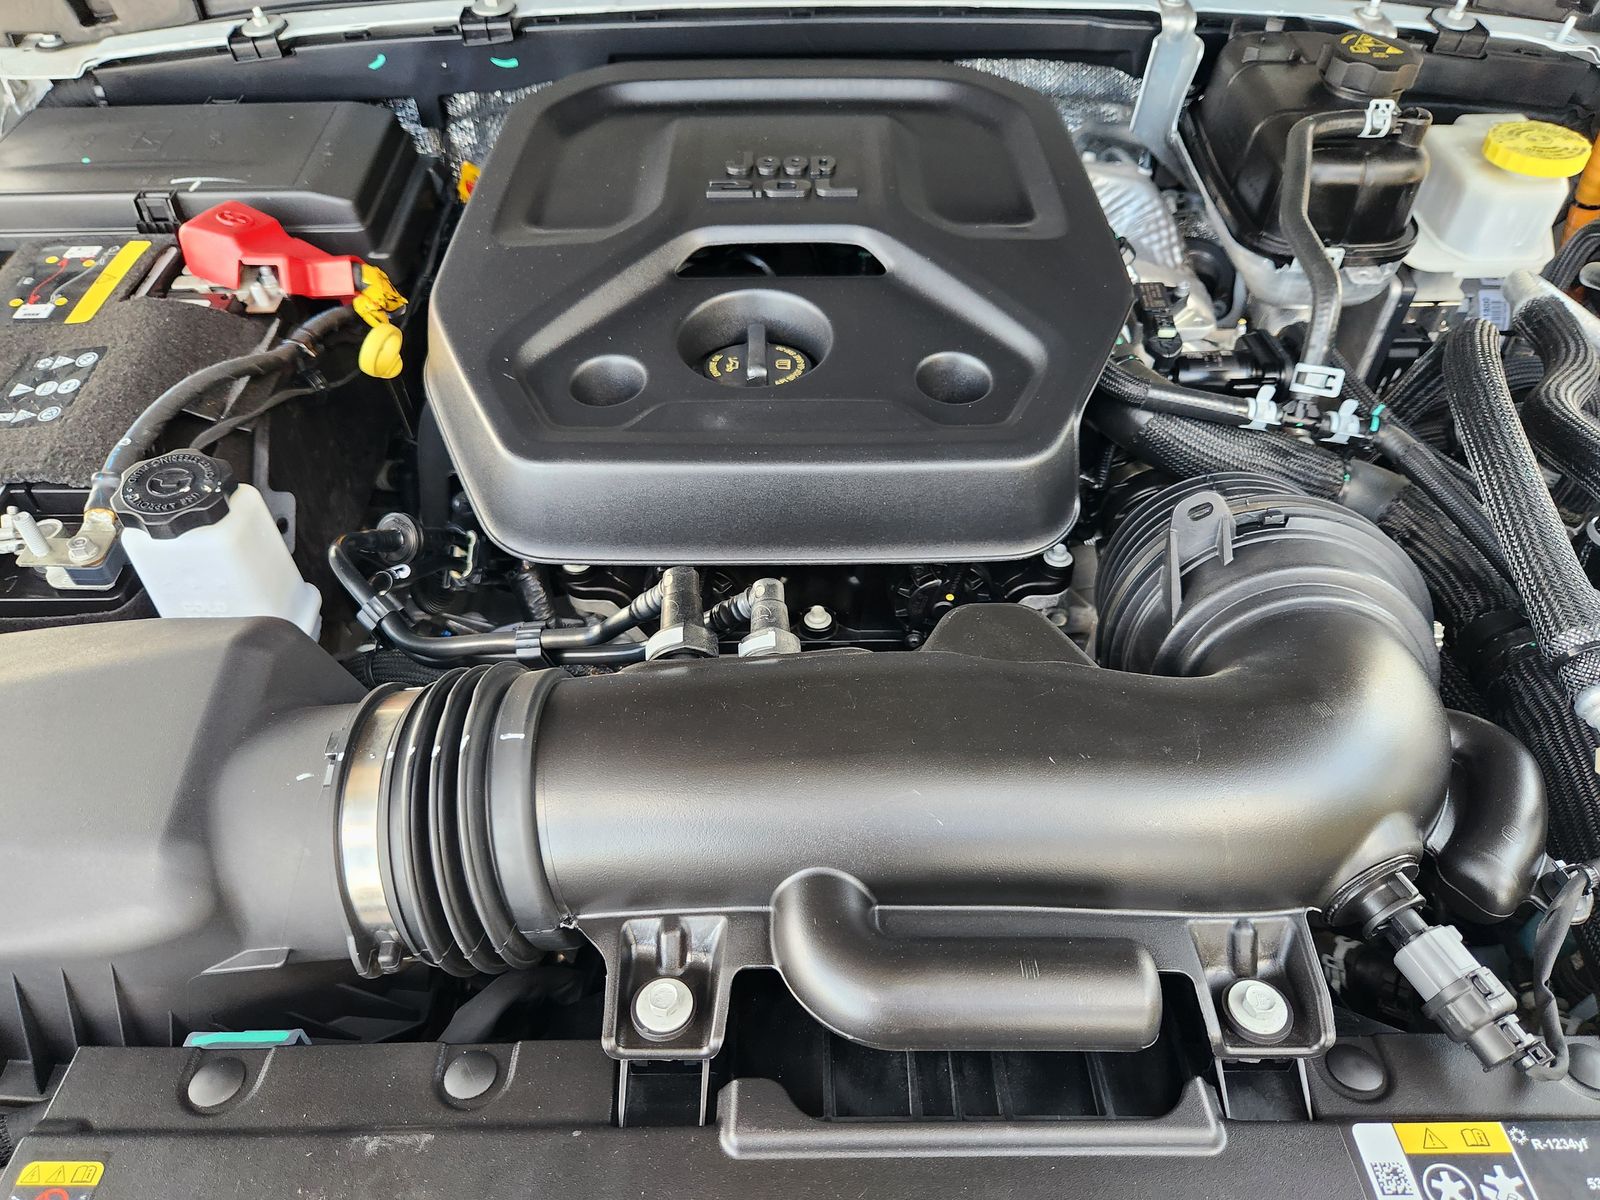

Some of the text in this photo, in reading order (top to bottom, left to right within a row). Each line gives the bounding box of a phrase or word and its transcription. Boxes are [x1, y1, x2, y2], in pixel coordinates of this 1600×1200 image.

[725, 151, 836, 178] Jeep
[706, 179, 858, 199] 2.0L
[1531, 1137, 1589, 1153] R-1234yf
